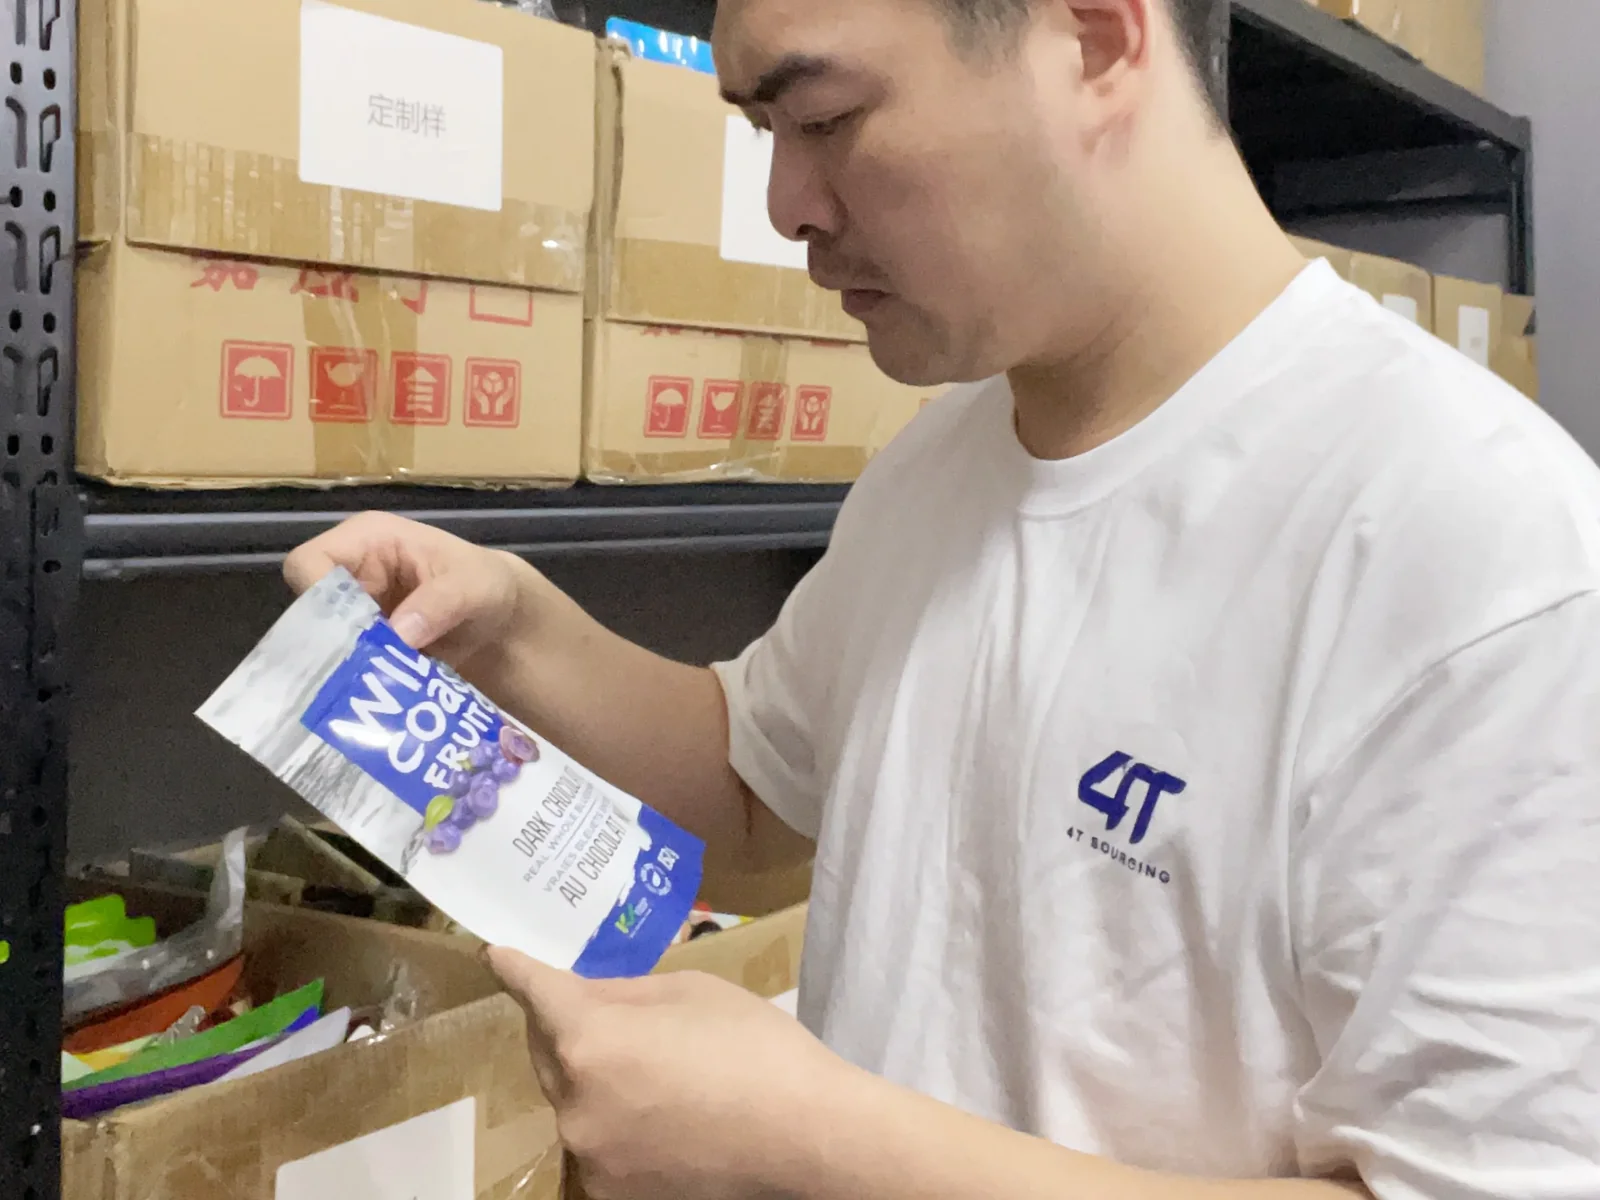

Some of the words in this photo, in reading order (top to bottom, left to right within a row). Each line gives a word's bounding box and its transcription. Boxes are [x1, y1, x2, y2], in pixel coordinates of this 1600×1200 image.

[367, 93, 447, 138] 定制样
[328, 643, 432, 747] WIL
[1078, 750, 1187, 844] 4T
[512, 810, 556, 858] DARK
[522, 853, 550, 883] REAL
[548, 813, 582, 851] WHOLE
[558, 875, 588, 909] AU
[576, 814, 628, 881] CHOCOLAT
[1066, 826, 1084, 842] 4T
[1090, 836, 1171, 884] SOURCING
